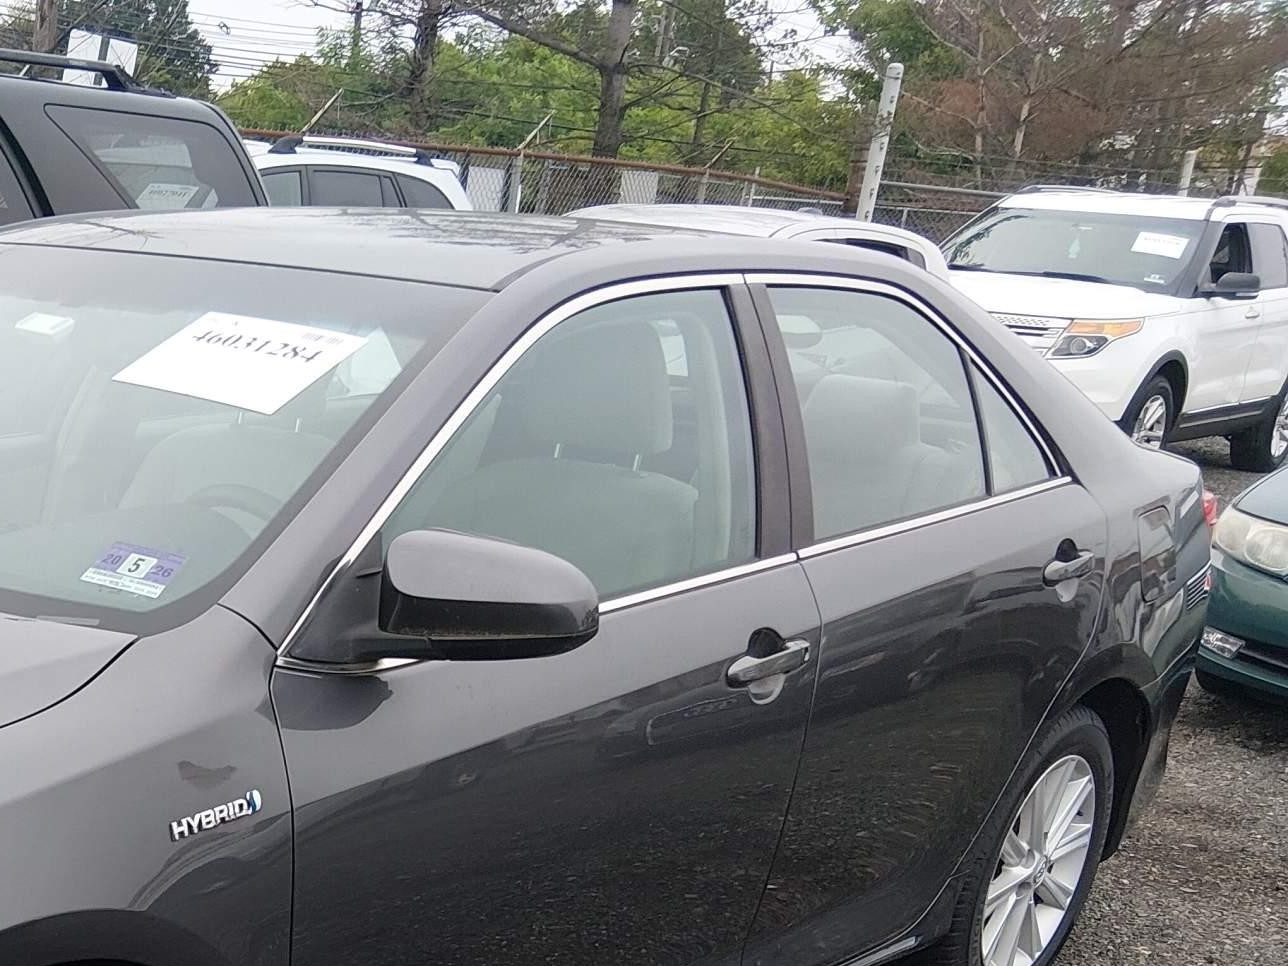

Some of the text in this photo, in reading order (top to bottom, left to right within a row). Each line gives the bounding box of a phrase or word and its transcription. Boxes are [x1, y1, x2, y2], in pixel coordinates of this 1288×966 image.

[192, 329, 324, 364] 46031284
[102, 553, 173, 578] 20 5 26
[170, 798, 252, 841] HYBRID
